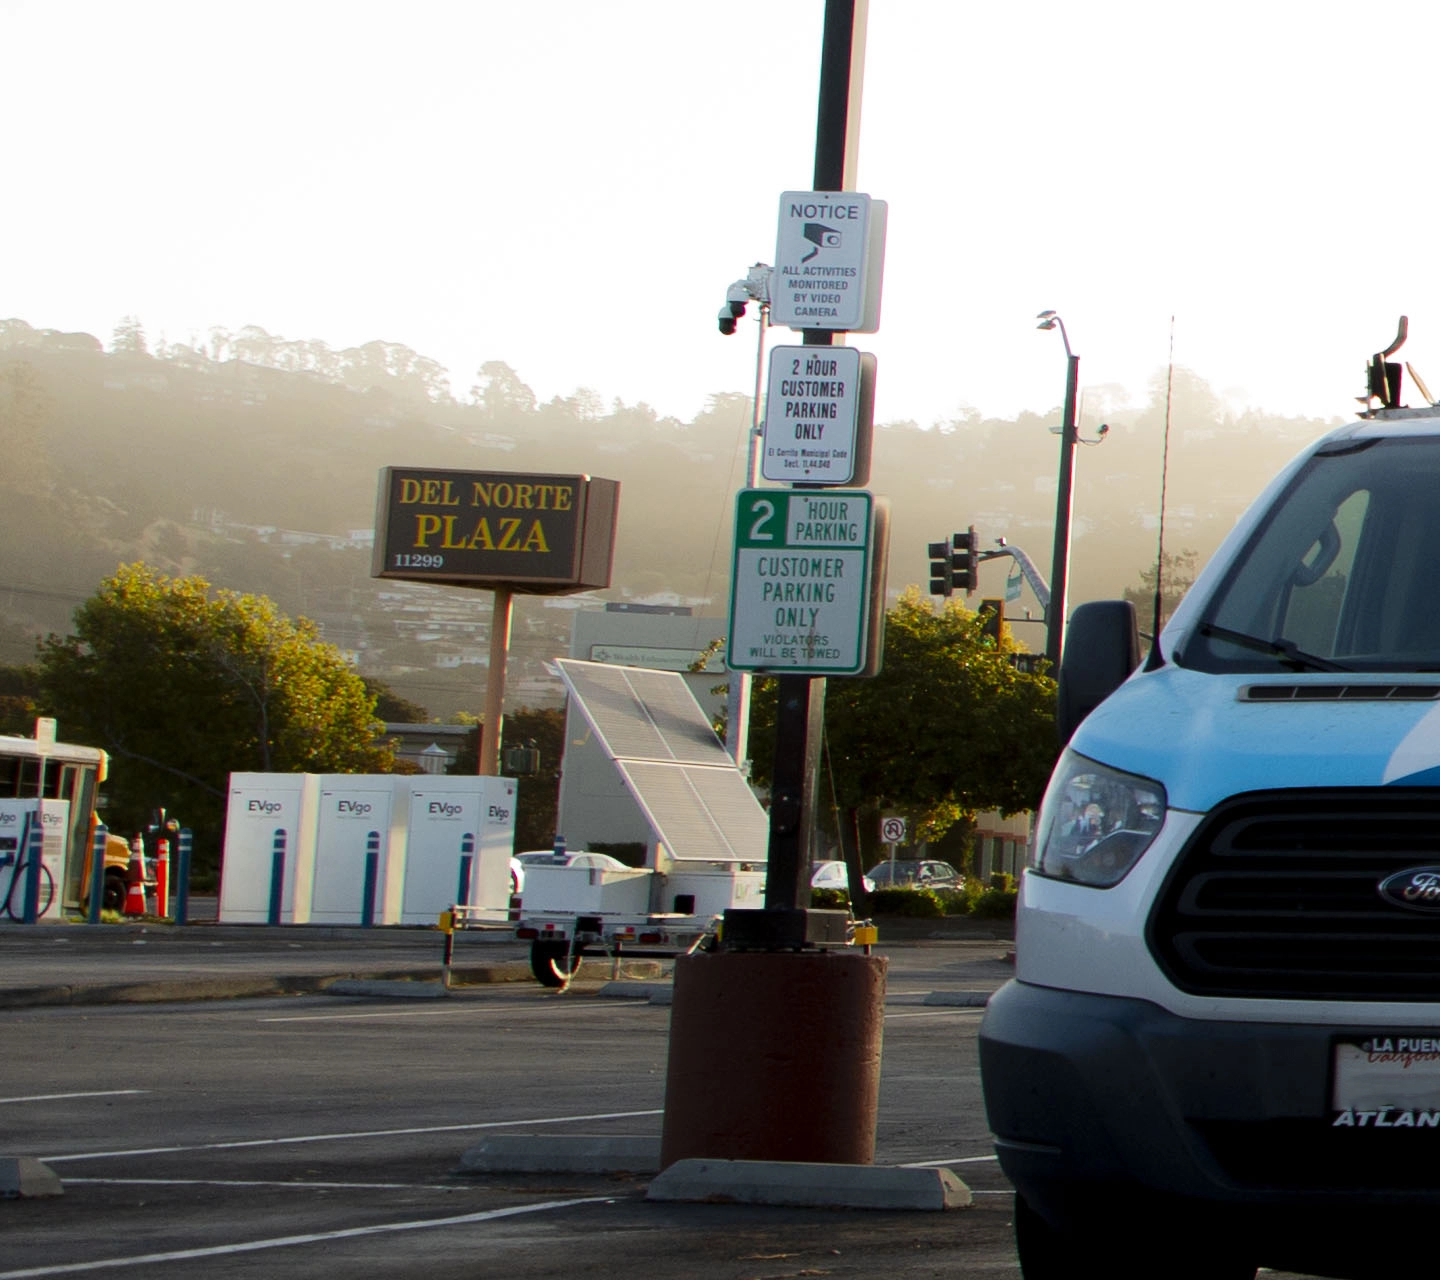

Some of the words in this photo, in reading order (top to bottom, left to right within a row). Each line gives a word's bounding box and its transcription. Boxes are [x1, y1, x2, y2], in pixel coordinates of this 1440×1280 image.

[790, 204, 859, 220] NOTICE
[782, 266, 800, 276] ALL
[802, 266, 857, 277] ACTIVITIES
[788, 279, 849, 290] MONITORED
[793, 293, 808, 303] BY
[810, 294, 841, 304] VIDEO
[794, 306, 838, 317] CAMERA
[792, 359, 800, 376] 2
[806, 359, 837, 376] HOUR
[781, 380, 845, 398] CUSTOMER
[785, 402, 837, 419] PARKING
[795, 423, 824, 440] ONLY
[801, 449, 830, 459] Municipal
[832, 449, 847, 459] Code
[400, 478, 460, 505] DEL
[471, 482, 573, 511] NORTE
[808, 502, 848, 520] HOUR
[749, 500, 775, 540] 2
[413, 514, 552, 553] PLAZA
[795, 522, 858, 542] PARKING
[394, 553, 444, 568] 11299
[758, 557, 845, 578] CUSTOMER
[762, 582, 836, 603] PARKING
[775, 607, 820, 627] ONLY
[763, 634, 829, 646] VIOLATORS
[749, 647, 777, 659] WILL
[781, 647, 796, 659] BE
[801, 648, 841, 659] TOWED
[248, 800, 281, 815] EVgo
[338, 800, 372, 816] EVgo
[428, 802, 462, 817] EVgo
[488, 805, 509, 821] EVgo
[1372, 1038, 1393, 1052] LA
